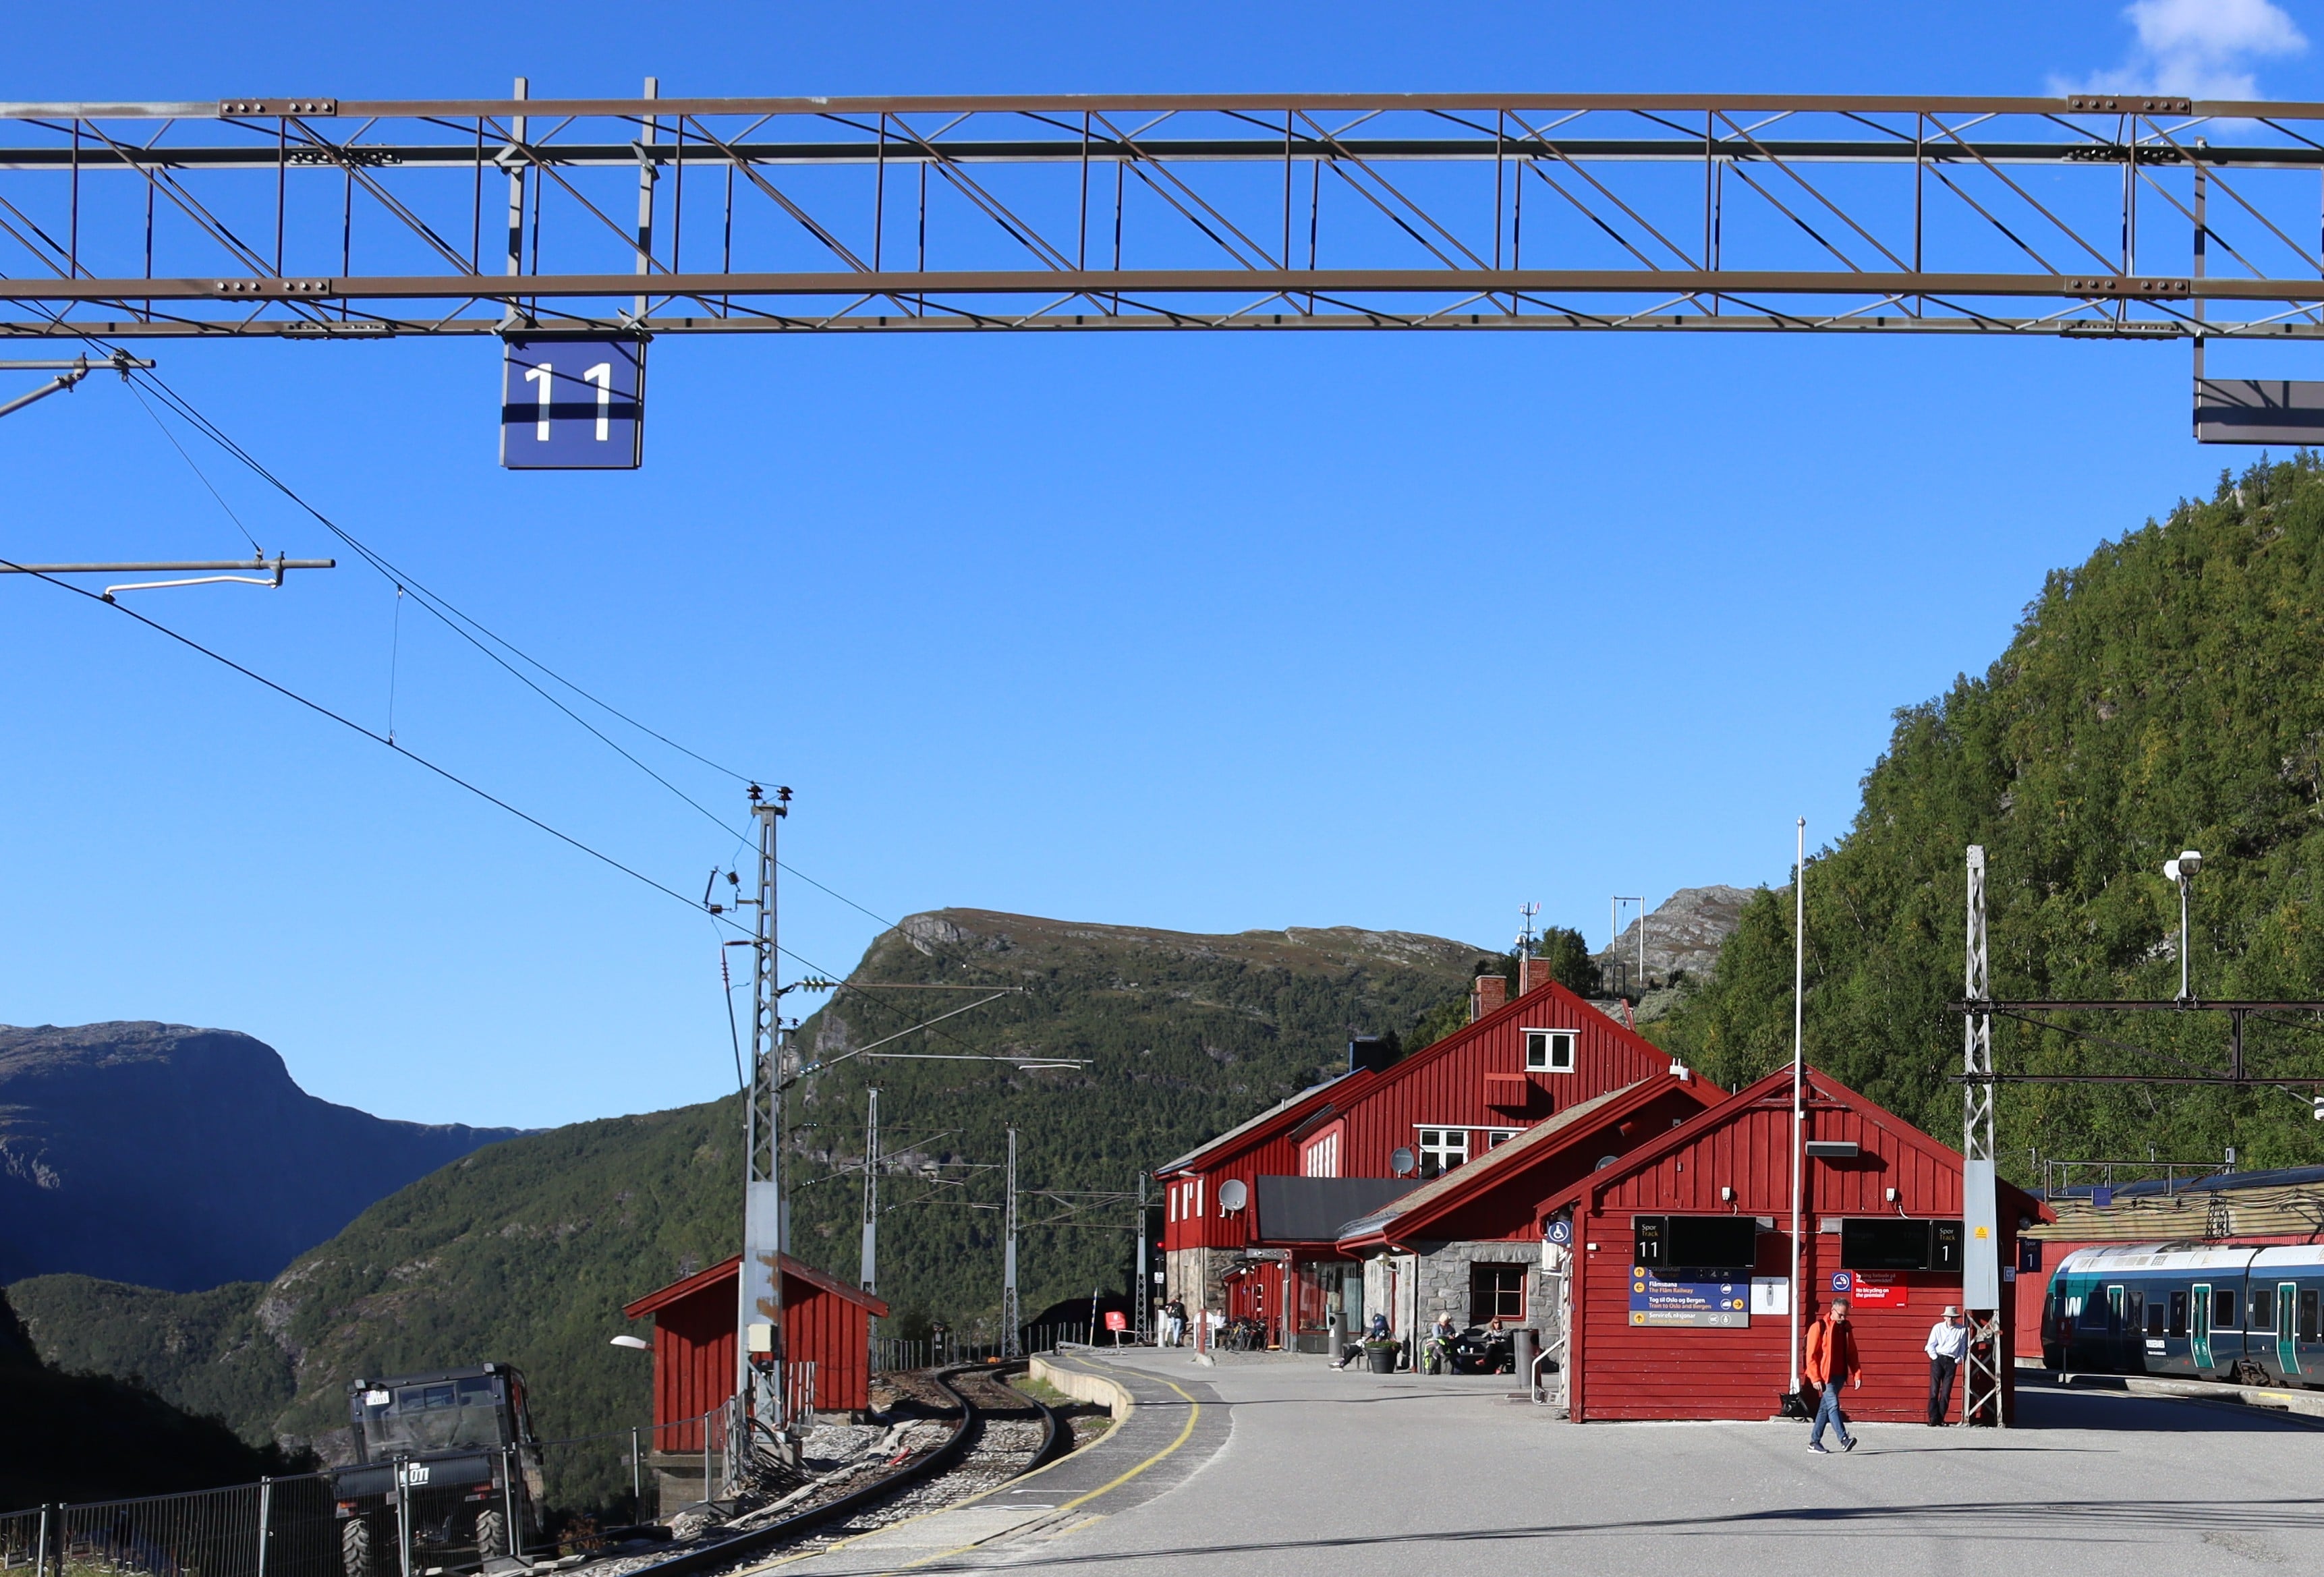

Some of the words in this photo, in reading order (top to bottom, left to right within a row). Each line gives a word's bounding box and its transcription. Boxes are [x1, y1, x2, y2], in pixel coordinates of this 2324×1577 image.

[525, 363, 611, 441] 11
[1639, 1241, 1657, 1257] 11
[1942, 1245, 1949, 1262] 1
[2027, 1253, 2034, 1267] 1
